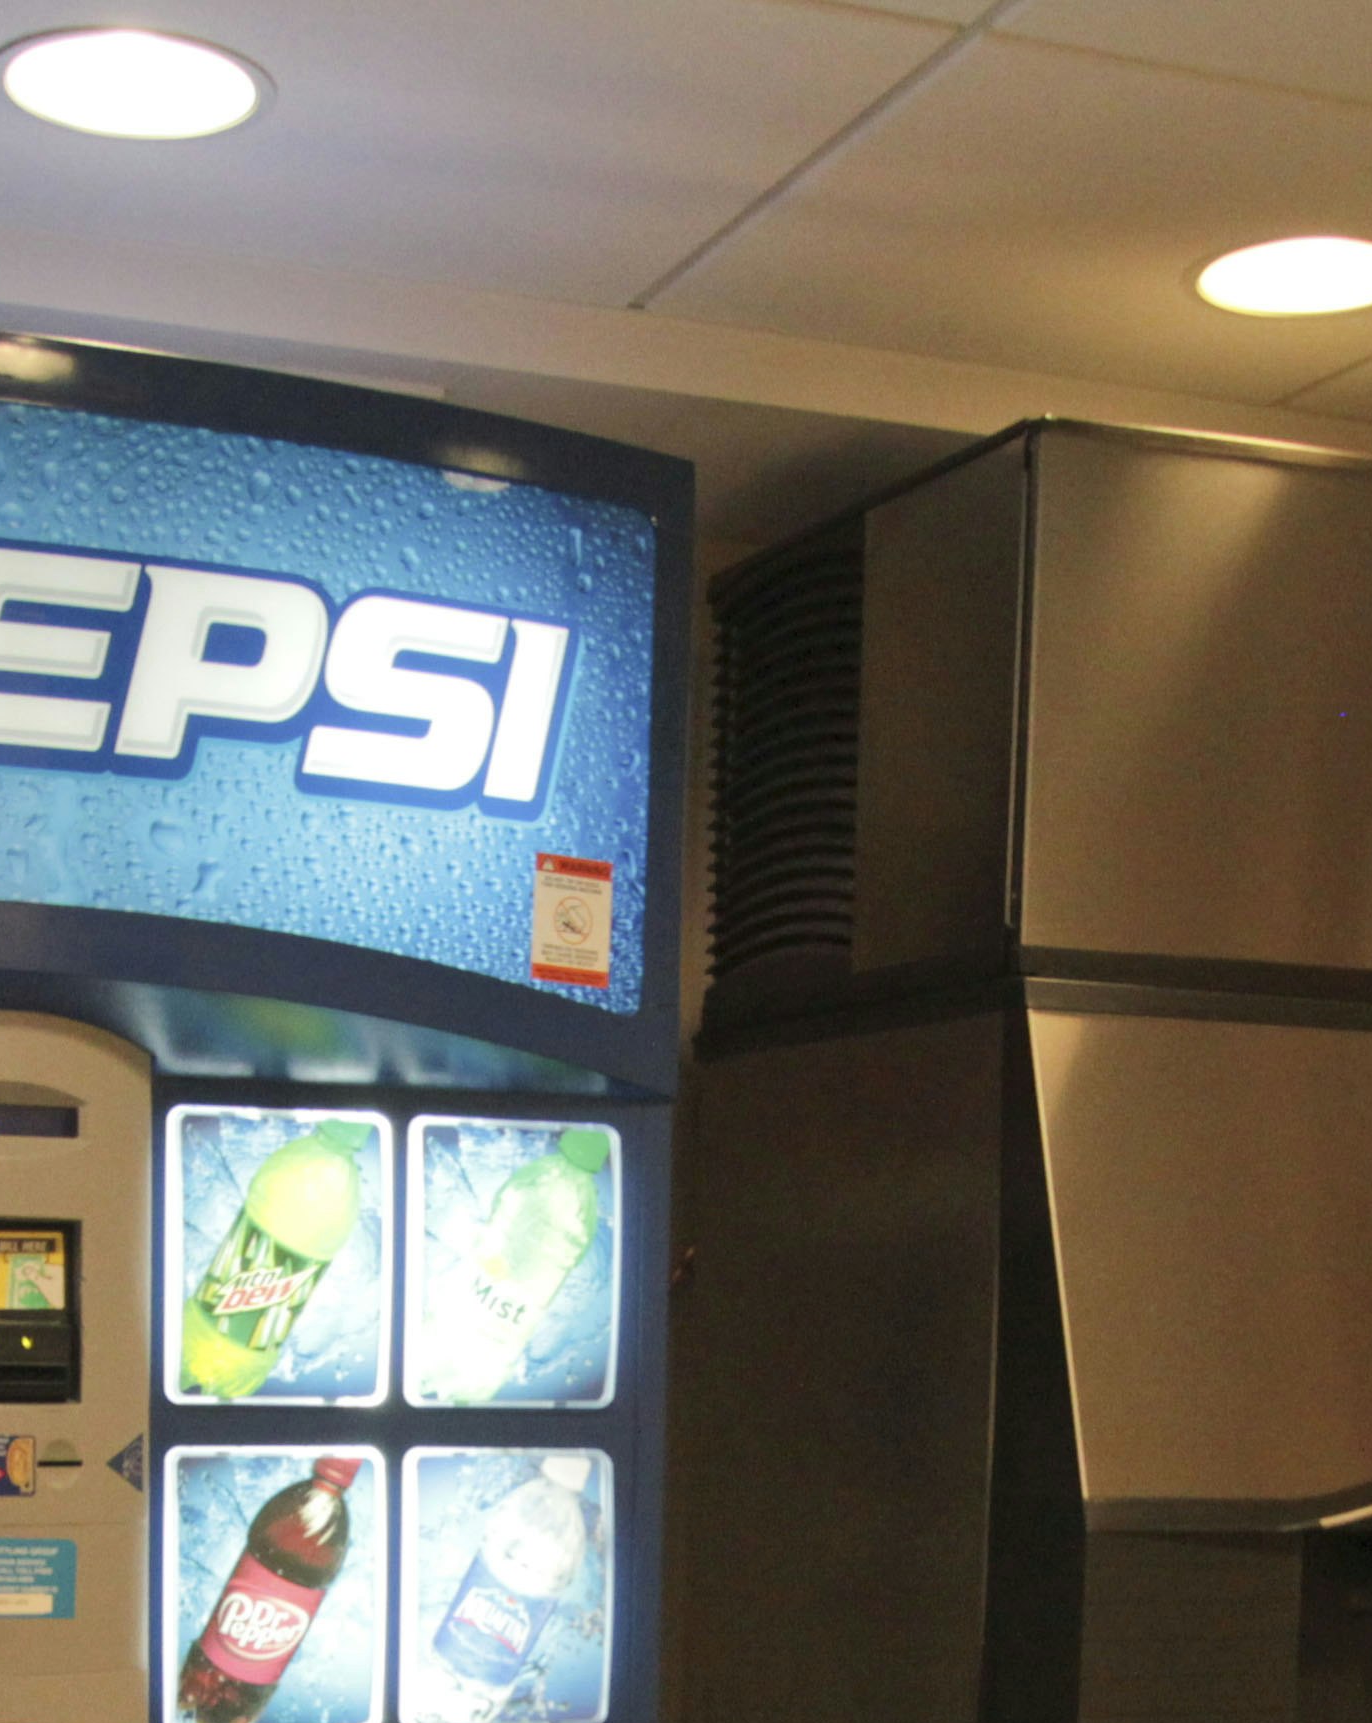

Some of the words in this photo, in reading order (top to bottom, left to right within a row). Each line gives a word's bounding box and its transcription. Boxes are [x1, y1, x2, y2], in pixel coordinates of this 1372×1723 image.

[469, 1275, 527, 1325] Mist
[219, 1592, 301, 1650] Pepper
[251, 1599, 289, 1628] Dr
